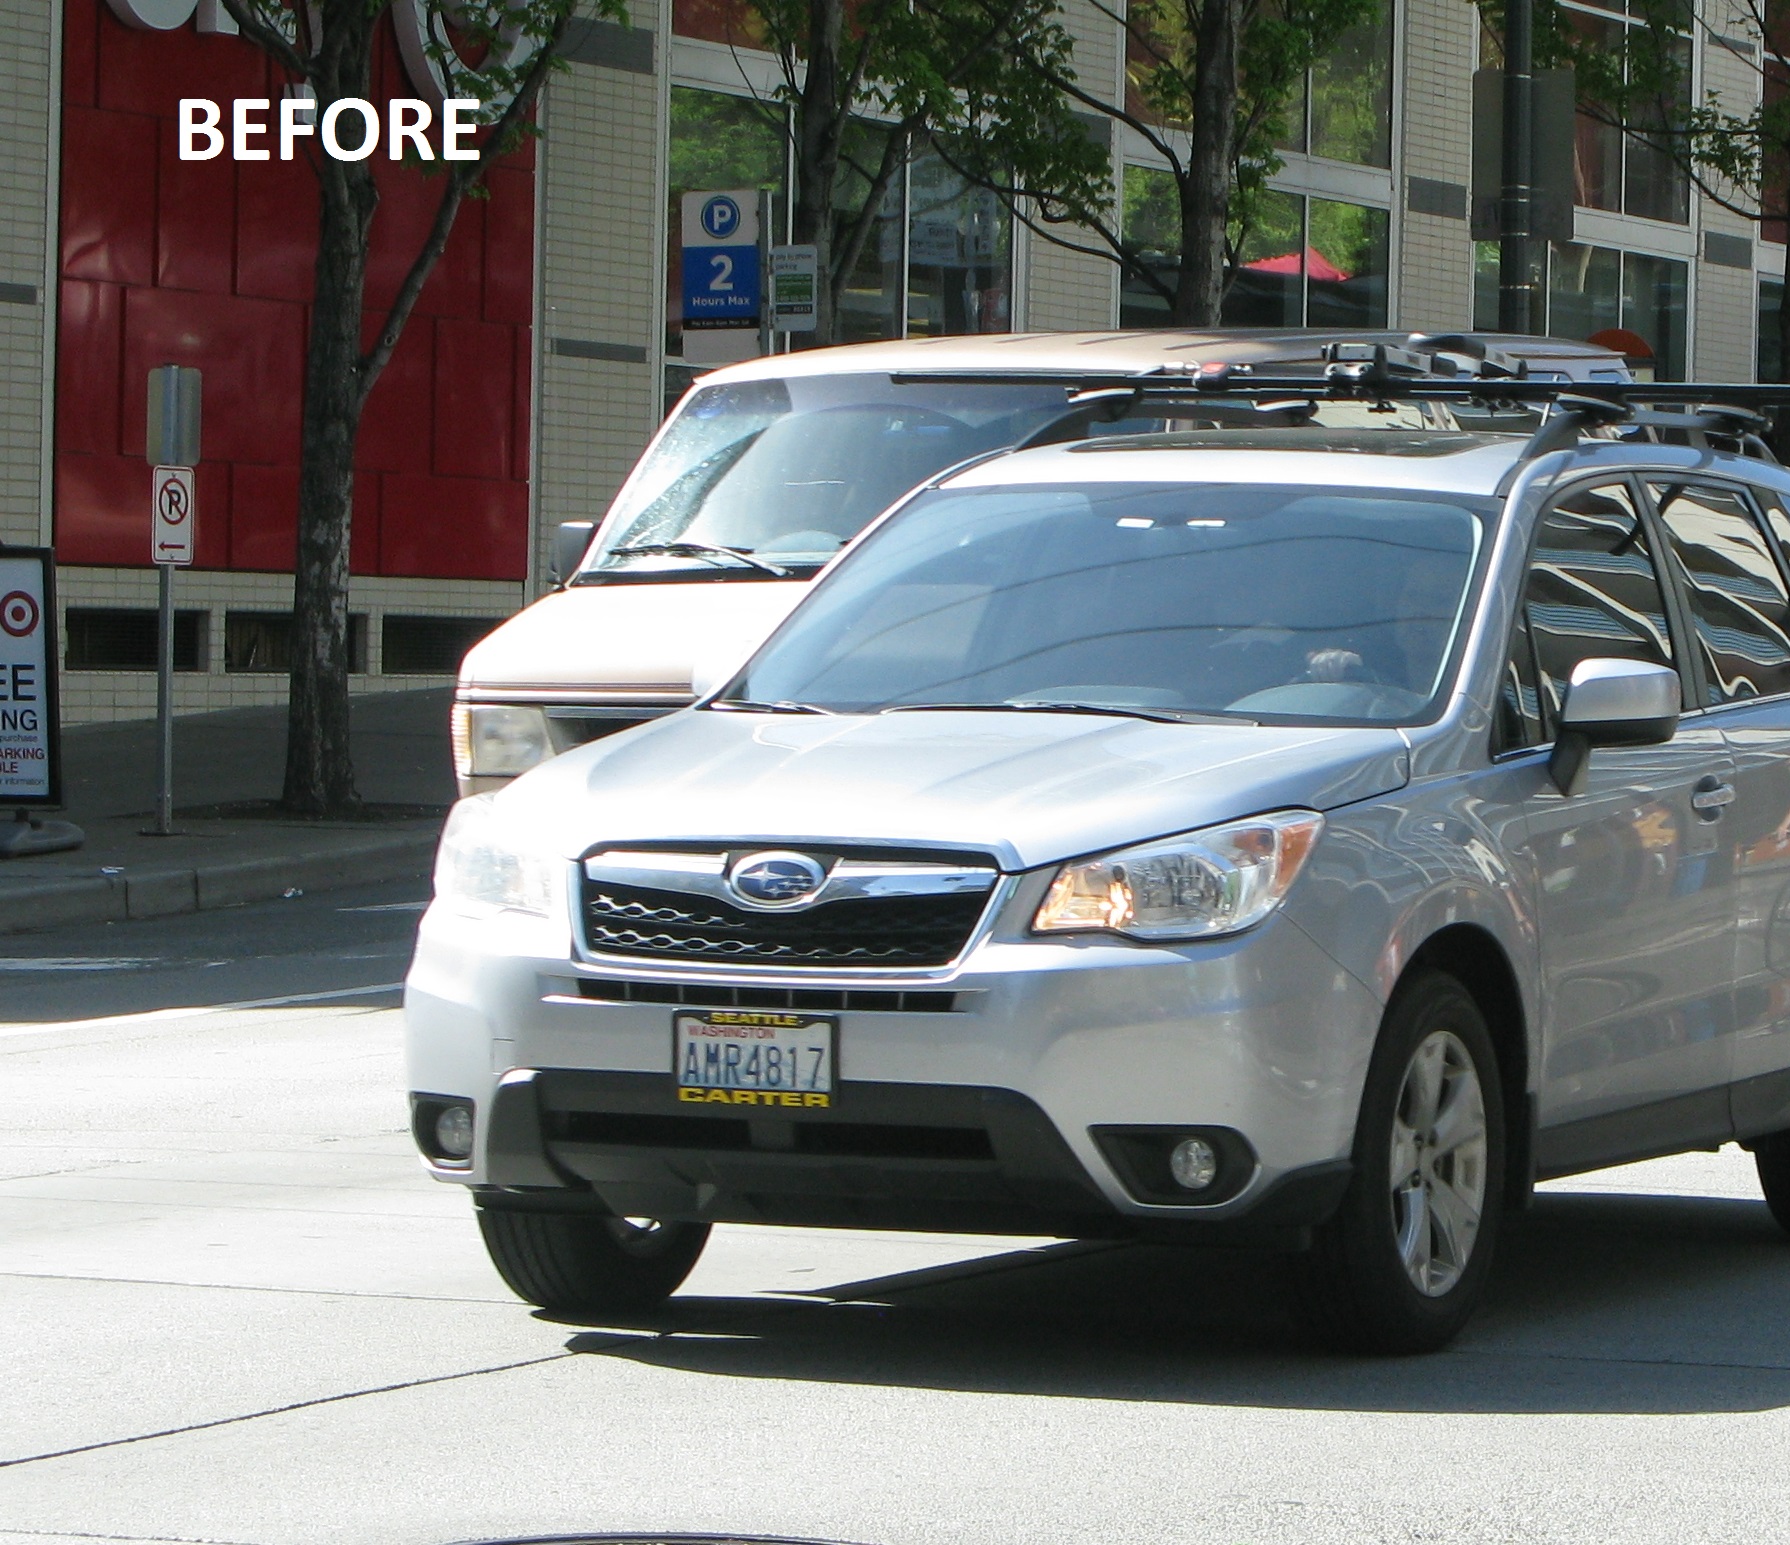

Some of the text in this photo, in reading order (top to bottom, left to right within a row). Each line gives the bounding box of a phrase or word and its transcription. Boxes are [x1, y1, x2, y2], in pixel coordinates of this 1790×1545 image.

[712, 204, 732, 231] P
[709, 254, 734, 292] 2
[692, 295, 750, 307] Hours Max
[710, 1012, 799, 1026] SEATTLE
[687, 1025, 776, 1039] WASHINGTON
[683, 1041, 825, 1089] AMR4817
[678, 1086, 831, 1108] CARTER
